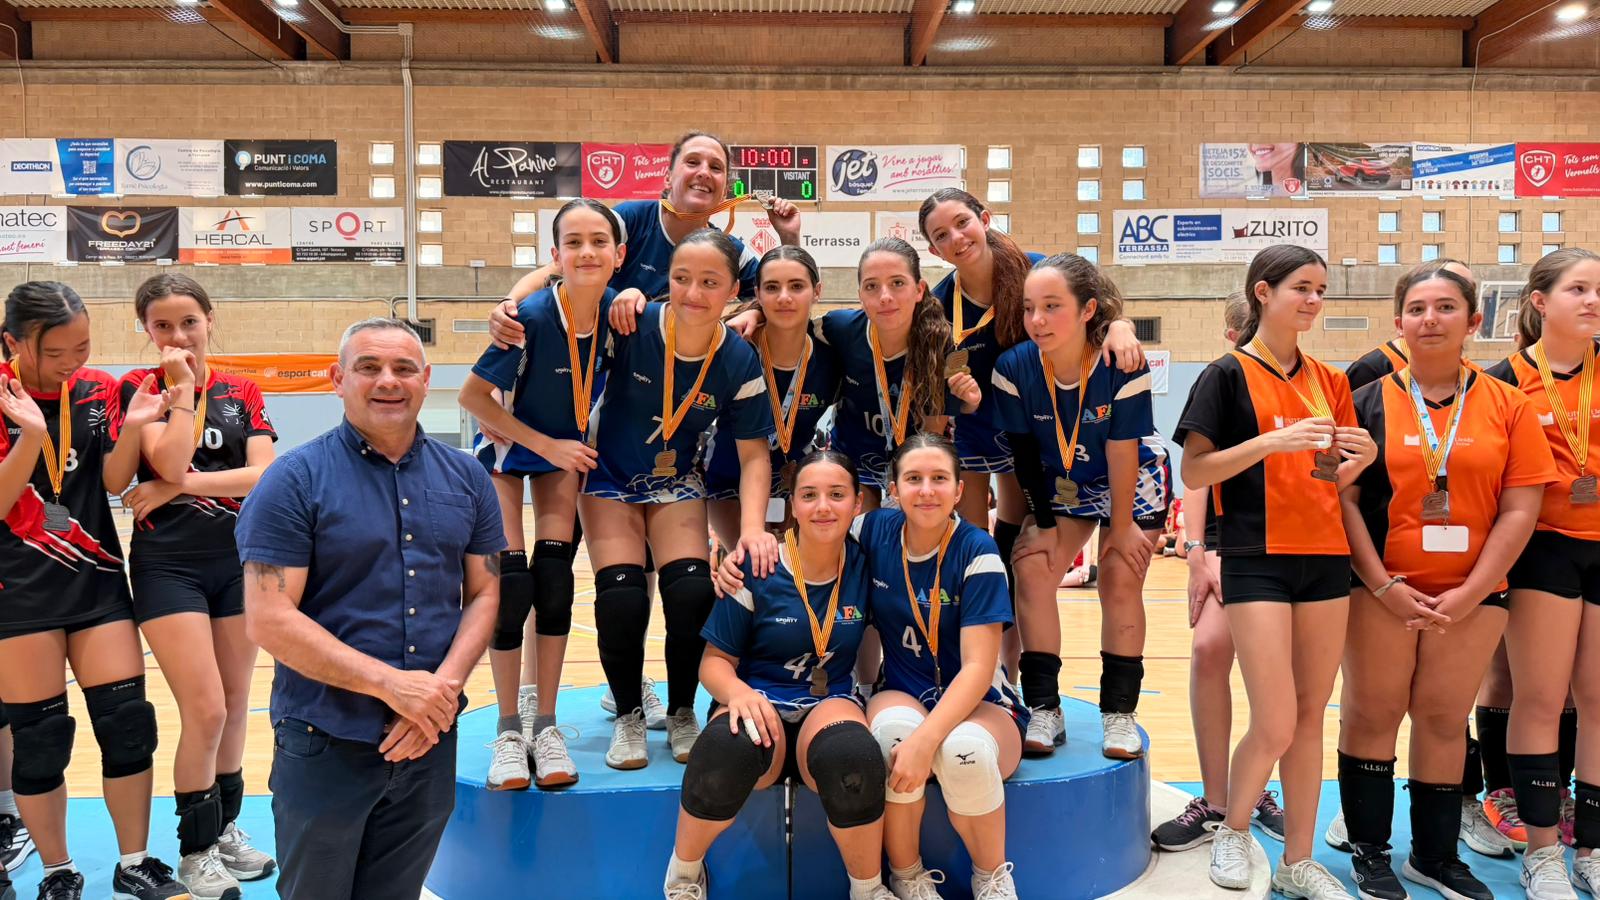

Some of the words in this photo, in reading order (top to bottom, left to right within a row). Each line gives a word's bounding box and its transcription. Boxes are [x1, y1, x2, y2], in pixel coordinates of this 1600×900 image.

[254, 154, 286, 164] PUNT
[294, 154, 327, 165] COMA
[592, 157, 621, 165] CHT
[632, 154, 649, 166] Tots
[741, 149, 791, 166] 10:00
[882, 154, 907, 168] Vine
[1524, 155, 1551, 164] CHT
[1563, 154, 1579, 165] Tots
[1582, 154, 1600, 163] som
[470, 147, 490, 187] Al
[831, 151, 878, 193] jet
[1208, 168, 1240, 177] SOCIS
[783, 172, 811, 180] VISITANT
[891, 170, 910, 179] amb
[801, 181, 812, 198] 0
[1119, 215, 1168, 243] ABC
[1250, 221, 1319, 236] ZURITO
[88, 240, 155, 248] FREEDAY21
[195, 234, 273, 246] HERCAL
[803, 235, 860, 247] Terrassa
[902, 625, 923, 658] 4
[1531, 779, 1557, 788] ALLSIX
